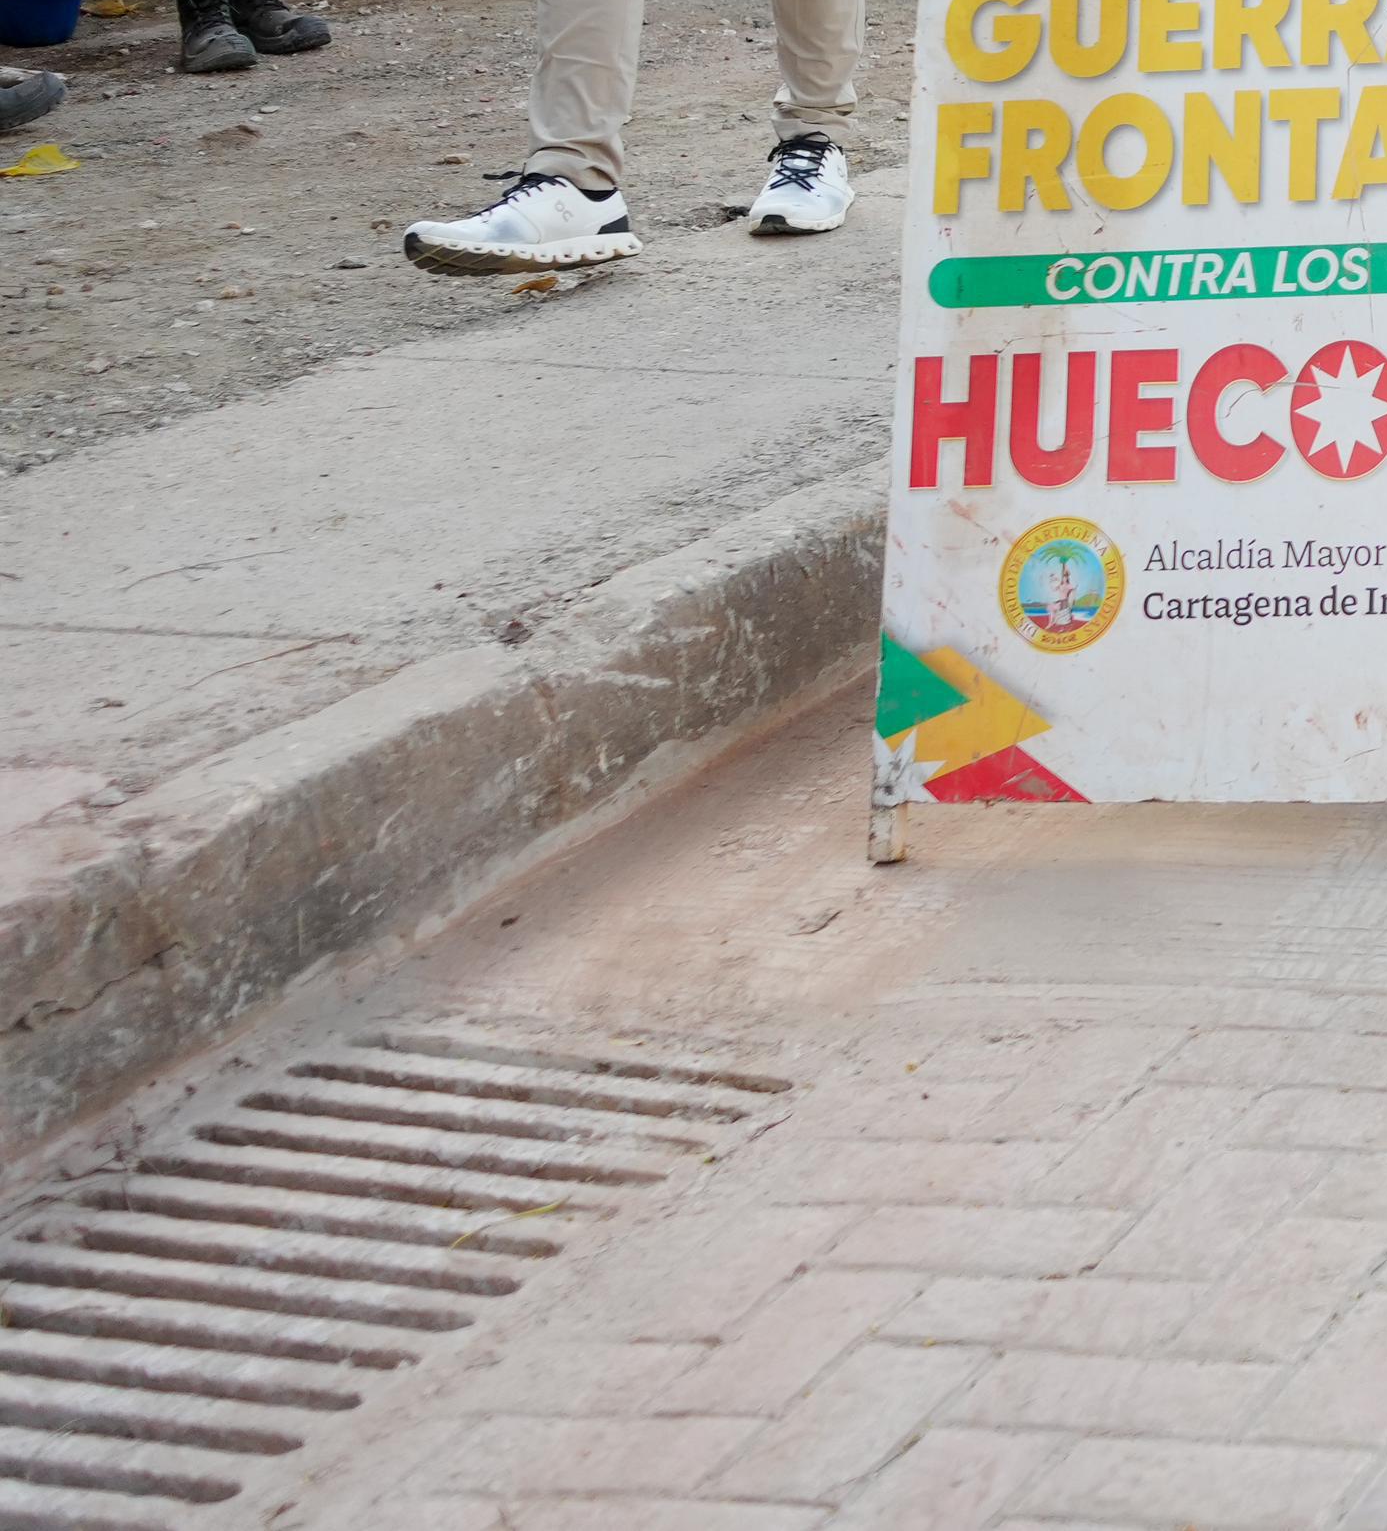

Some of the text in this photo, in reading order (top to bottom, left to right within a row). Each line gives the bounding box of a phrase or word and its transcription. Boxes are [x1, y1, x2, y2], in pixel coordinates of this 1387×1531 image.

[1046, 246, 1372, 302] CONTRA LOS
[1143, 537, 1275, 572] Alcaldía
[1281, 539, 1387, 575] Mayor
[1143, 591, 1313, 626] Cartagena
[1319, 584, 1358, 617] de
